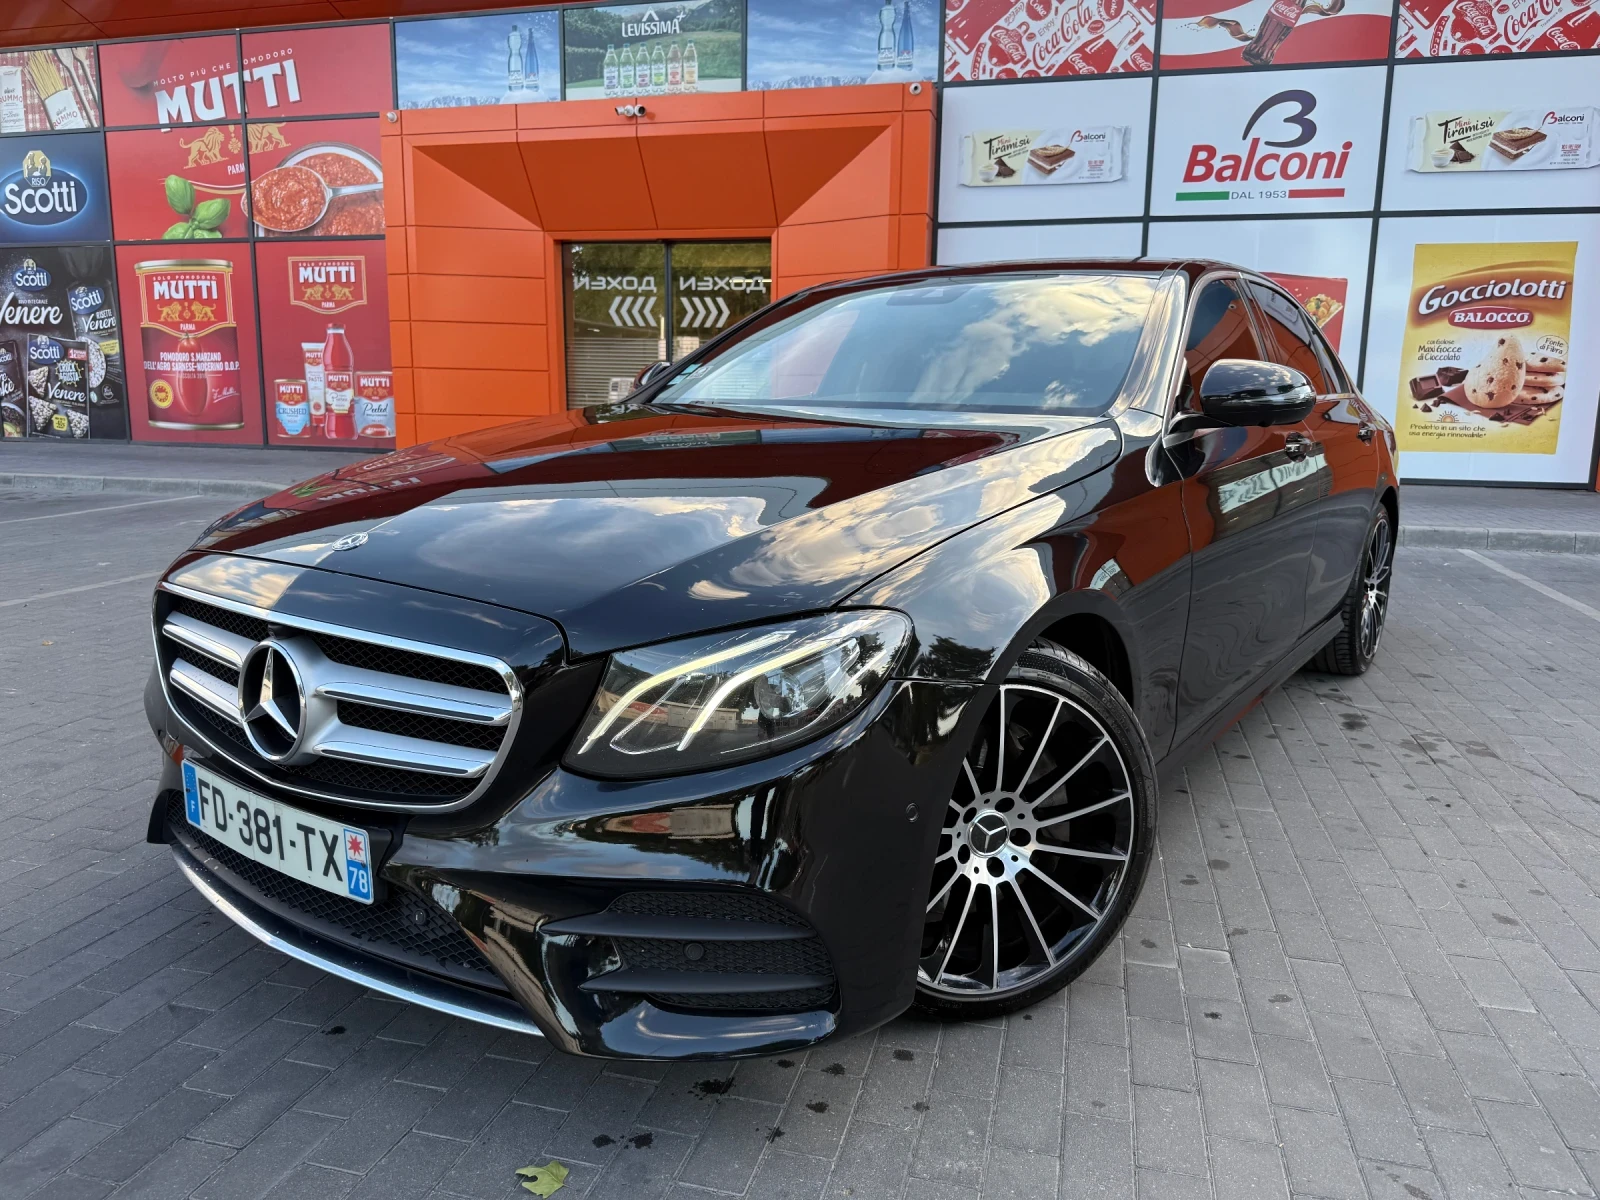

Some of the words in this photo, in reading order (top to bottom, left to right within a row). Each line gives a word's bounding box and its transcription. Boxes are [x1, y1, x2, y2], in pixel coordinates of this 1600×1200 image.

[1037, 18, 1056, 37] Enjoy
[153, 73, 185, 87] MOLTO
[190, 67, 207, 78] PIÙ
[212, 62, 231, 72] CHE
[240, 48, 294, 65] OMODORO
[155, 59, 301, 132] MUTTI
[1455, 118, 1472, 129] Mini
[1541, 111, 1585, 126] Balconi
[1070, 129, 1106, 143] Balconi
[1183, 138, 1353, 183] Balconi
[227, 162, 246, 176] PARM
[31, 177, 46, 186] RISO
[4, 181, 77, 215] Scotti
[1231, 191, 1255, 200] DAL
[1258, 190, 1287, 199] 1953
[15, 272, 48, 287] Scotti
[299, 266, 356, 283] MUTTI
[153, 279, 219, 300] MUTTI
[573, 276, 657, 293] ИЗХОД
[679, 276, 767, 294] ИЗХОД
[71, 289, 103, 312] Scotti
[1418, 278, 1567, 315] Gocciolotti
[30, 346, 60, 360] Scotti
[1417, 345, 1436, 353] Maxi
[1424, 353, 1461, 361] Cioccolato
[328, 374, 349, 382] MUTTI
[360, 377, 390, 387] MUTTI
[47, 382, 87, 402] Venere
[279, 385, 303, 394] MUTTI
[190, 800, 196, 813] F
[198, 778, 344, 883] FD-381-TX
[349, 866, 369, 893] 78
